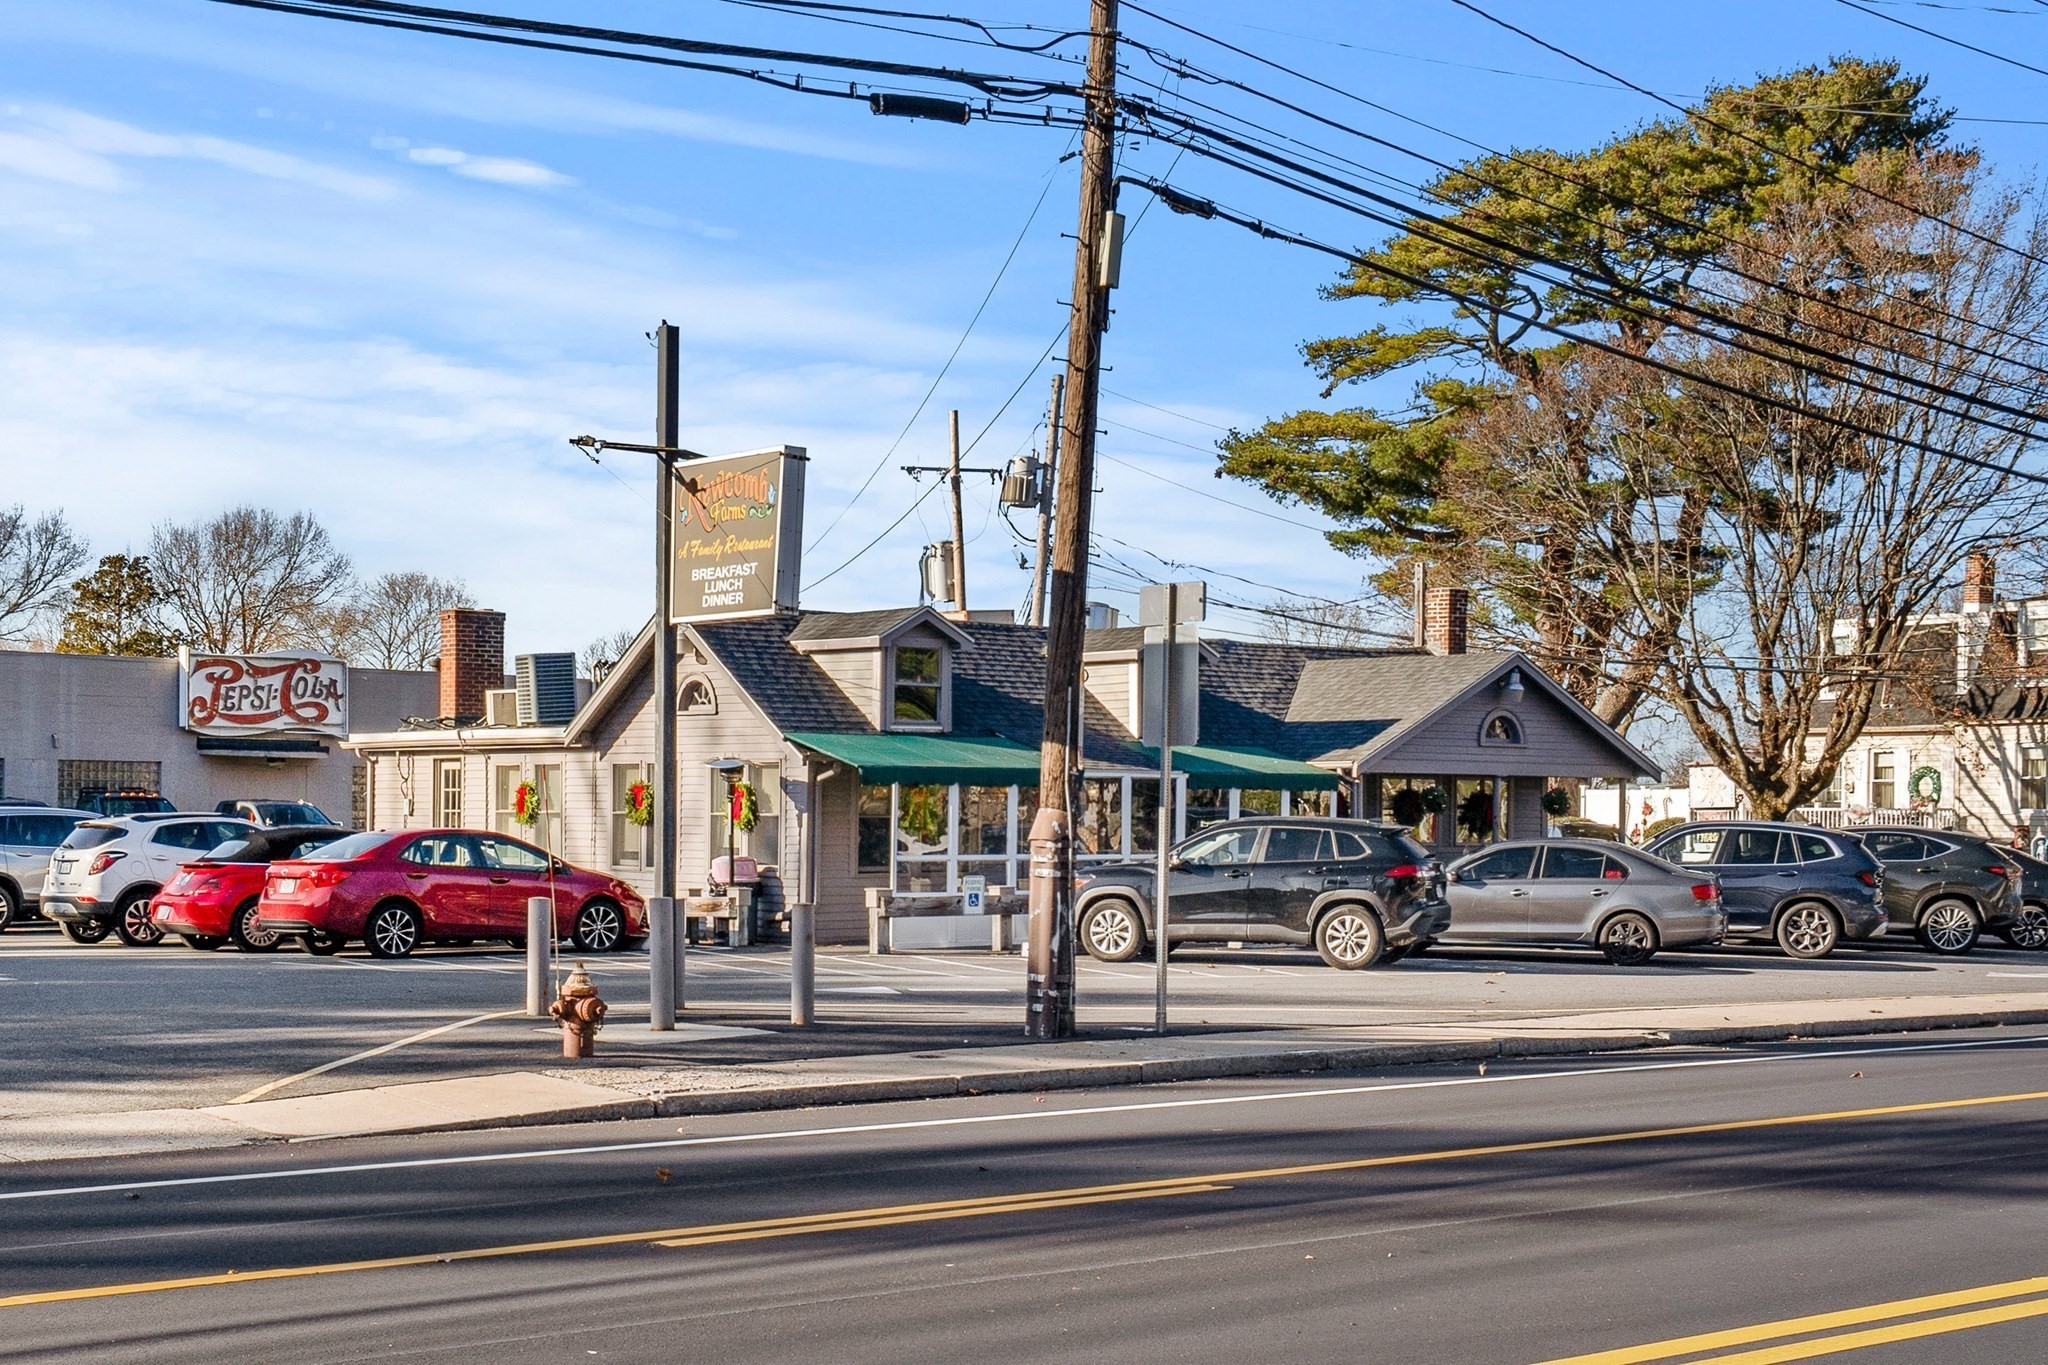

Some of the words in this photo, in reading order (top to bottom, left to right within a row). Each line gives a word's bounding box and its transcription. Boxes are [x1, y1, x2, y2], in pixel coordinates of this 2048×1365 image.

[679, 468, 769, 533] Newcomb
[710, 499, 747, 525] Farms
[679, 542, 688, 559] A
[691, 539, 724, 561] Family
[724, 535, 774, 555] Restaurant
[692, 562, 758, 581] BREAKFAST
[705, 578, 743, 593] LUNCH
[702, 592, 744, 608] DINNER
